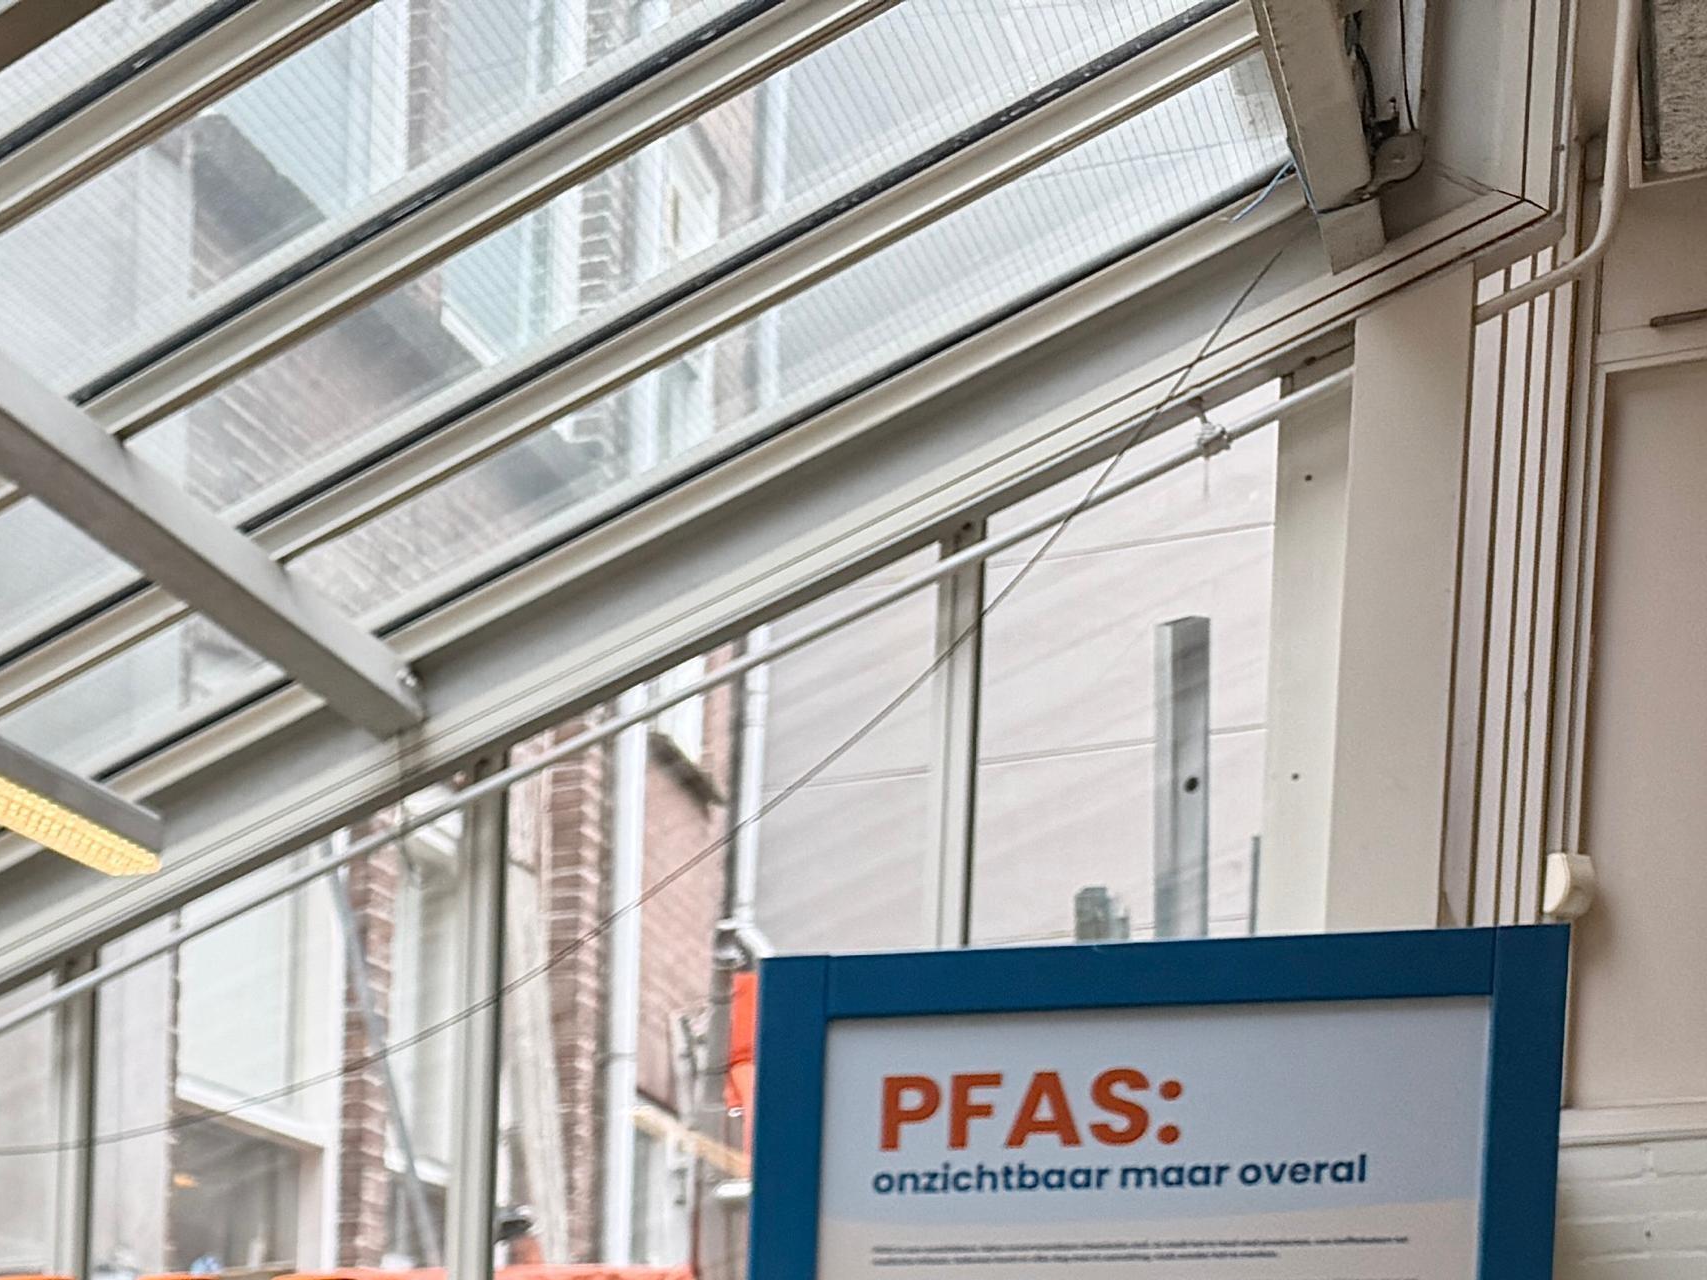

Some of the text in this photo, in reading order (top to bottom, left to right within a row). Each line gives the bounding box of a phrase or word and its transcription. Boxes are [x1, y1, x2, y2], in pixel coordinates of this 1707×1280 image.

[878, 1067, 1183, 1151] PFAS:
[873, 1154, 1367, 1195] onzichtbaar maar overal
